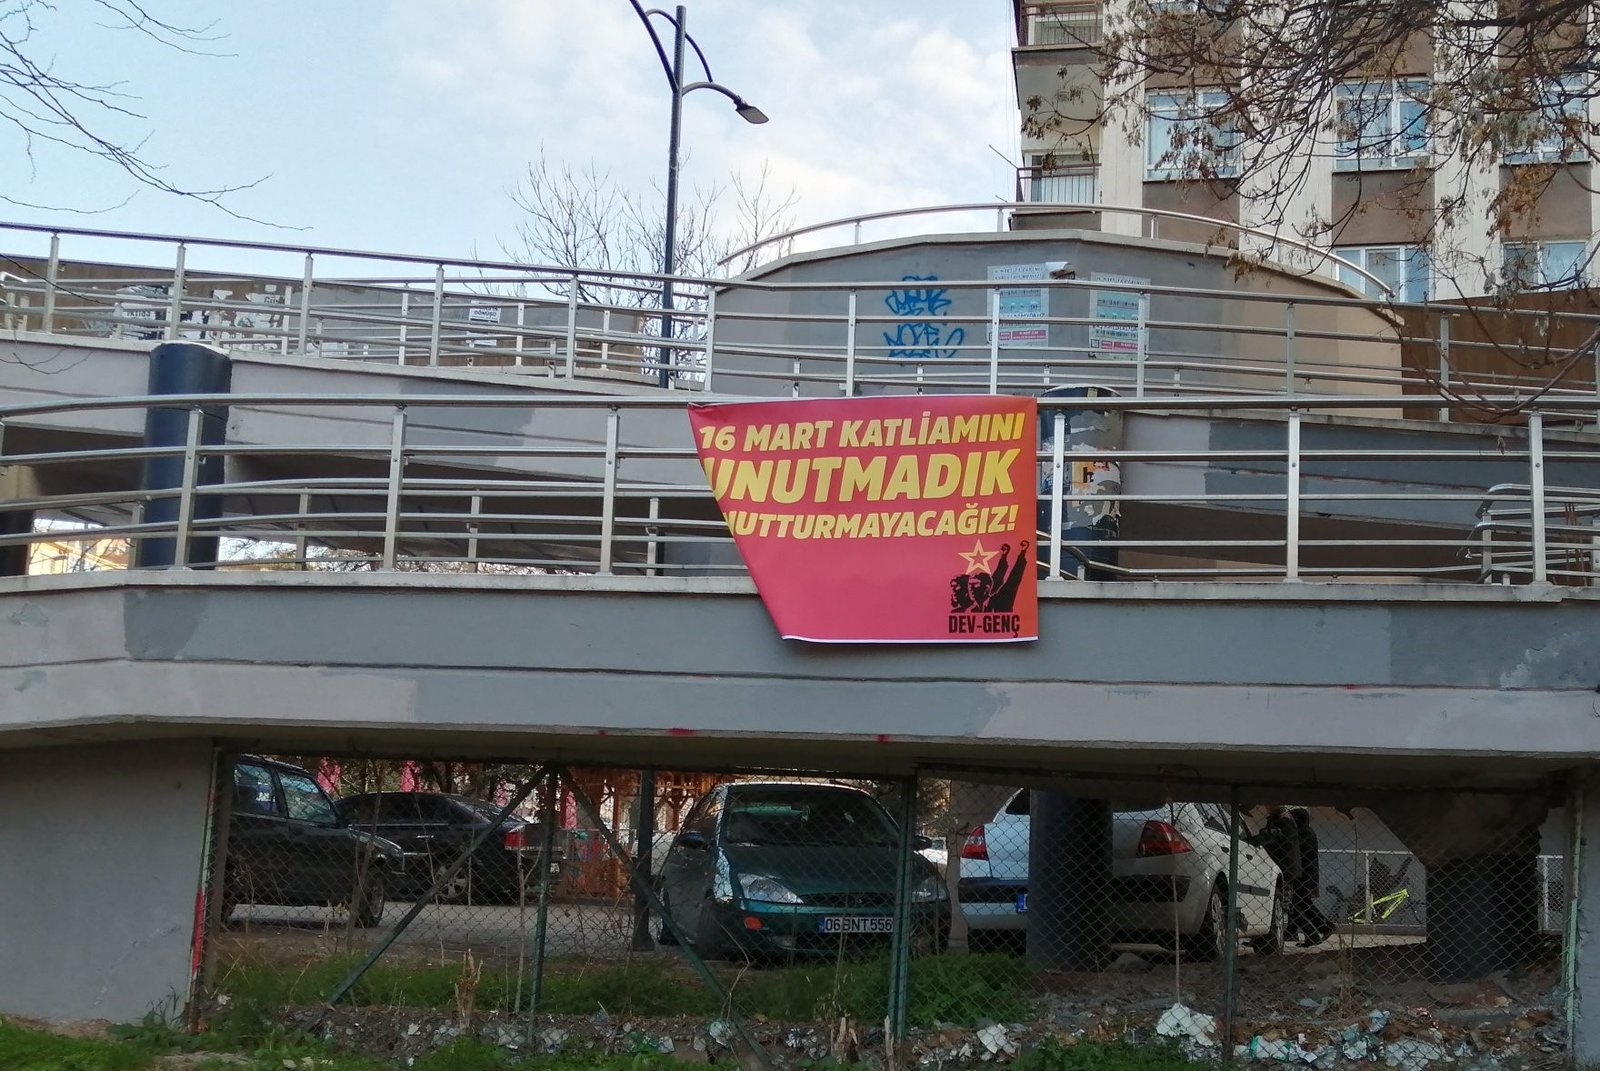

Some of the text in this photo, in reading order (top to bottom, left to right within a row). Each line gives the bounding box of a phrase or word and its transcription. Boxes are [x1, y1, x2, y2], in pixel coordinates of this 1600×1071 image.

[699, 410, 1026, 452] 16 MART KATLİAMINI
[703, 448, 1021, 504] UNUTMADIK
[948, 614, 1020, 638] DEV-GENÇ
